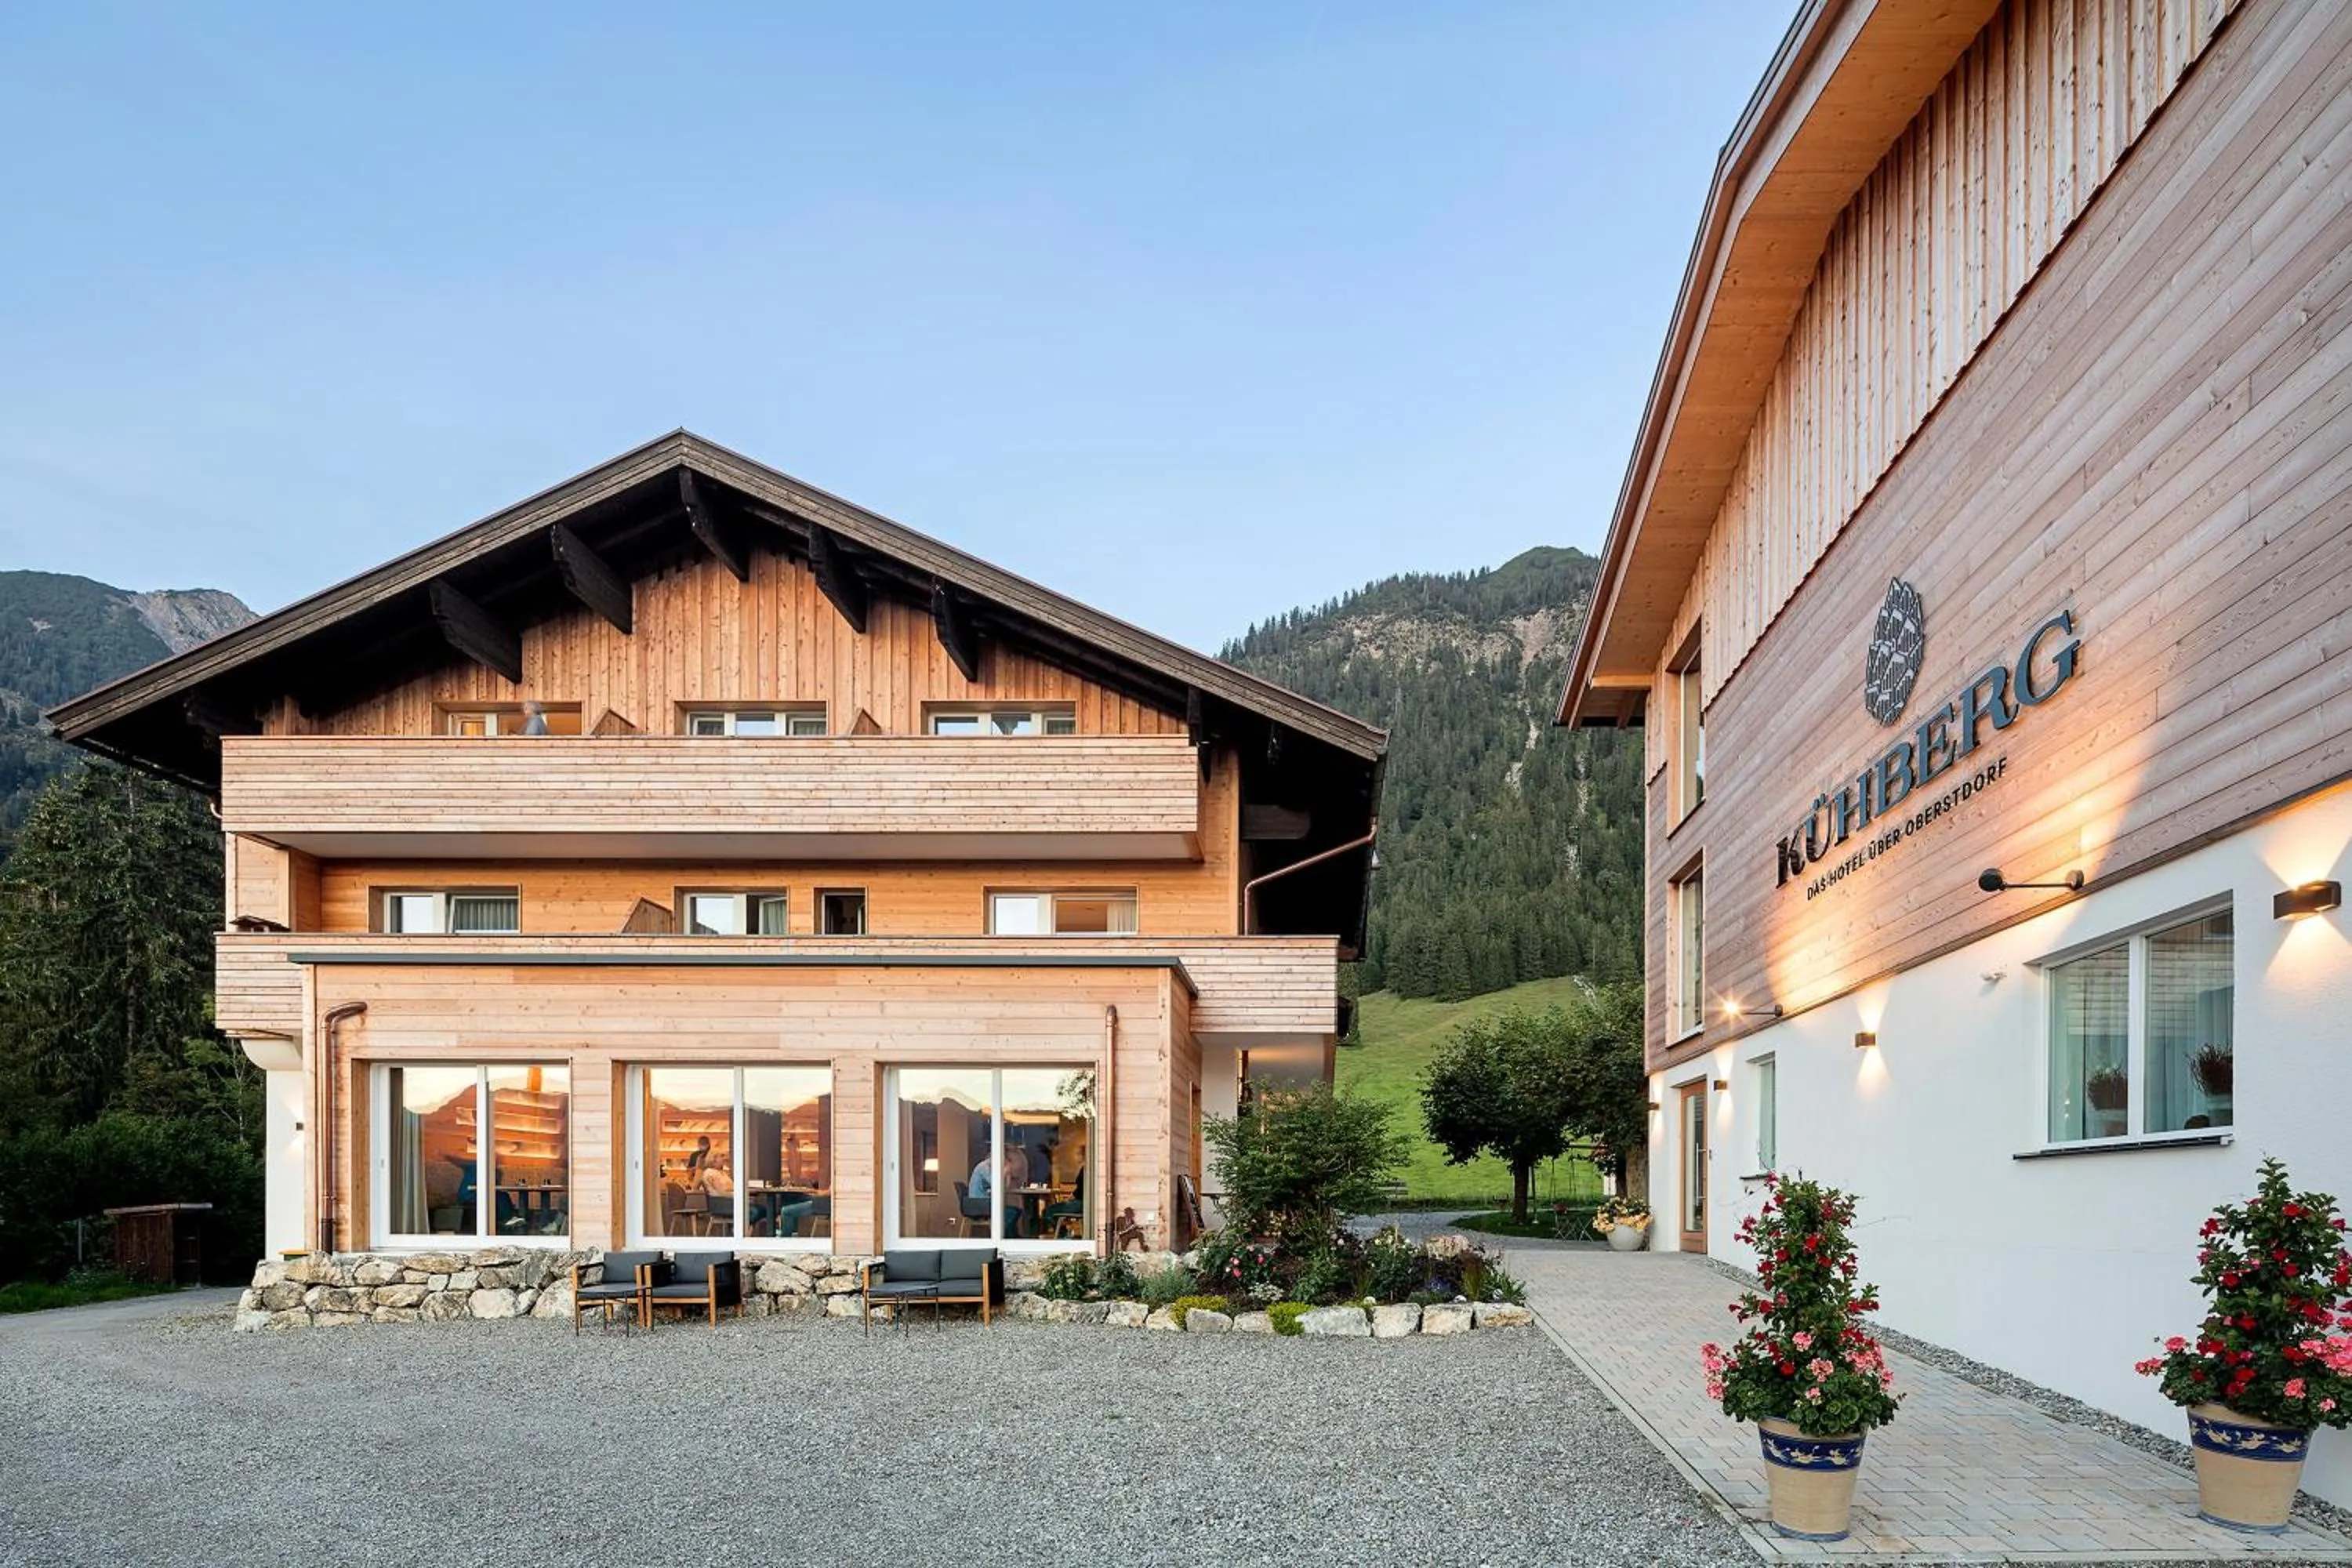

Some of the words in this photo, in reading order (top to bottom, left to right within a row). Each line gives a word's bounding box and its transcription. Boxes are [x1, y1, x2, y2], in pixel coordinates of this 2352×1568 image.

[1775, 609, 2082, 889] KÜHBERG
[1807, 876, 1826, 901] DAS
[1828, 853, 1864, 885] HOTEL
[1868, 828, 1900, 860] ÜBER
[1905, 757, 2007, 837] OBERSTDORF
